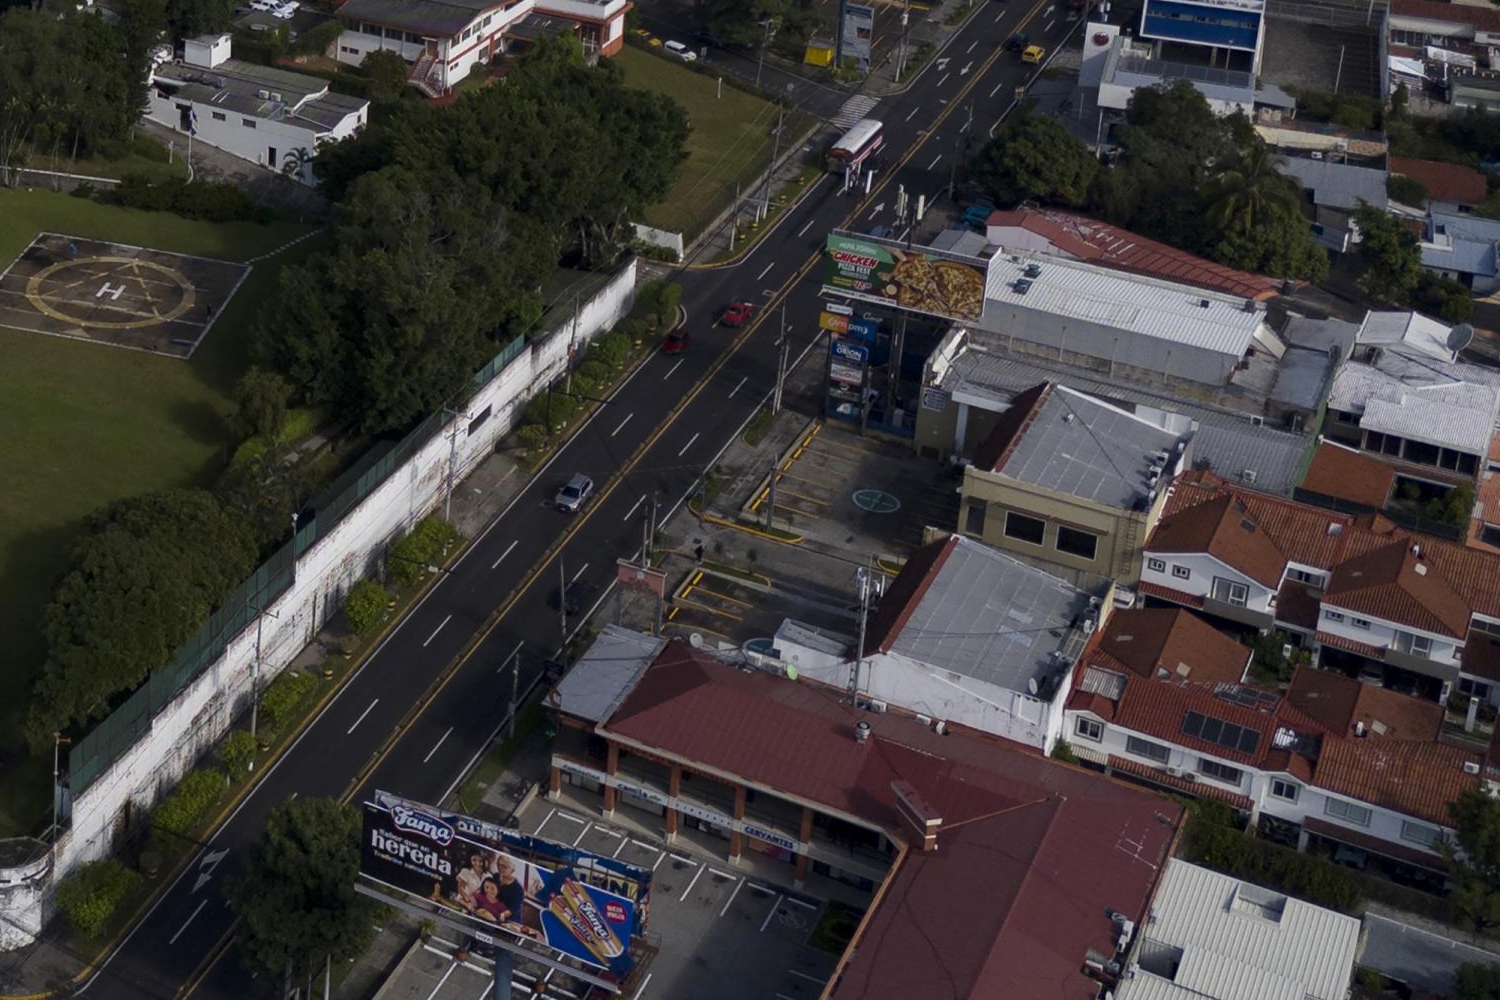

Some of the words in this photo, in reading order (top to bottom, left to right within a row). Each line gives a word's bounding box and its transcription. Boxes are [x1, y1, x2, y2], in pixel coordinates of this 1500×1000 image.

[834, 251, 878, 267] CHICKEN
[838, 262, 855, 272] PIZZA
[95, 281, 127, 300] H
[394, 806, 450, 841] Fama
[744, 826, 794, 849] CERVANTES
[371, 828, 452, 876] hereda
[580, 901, 610, 939] Fama
